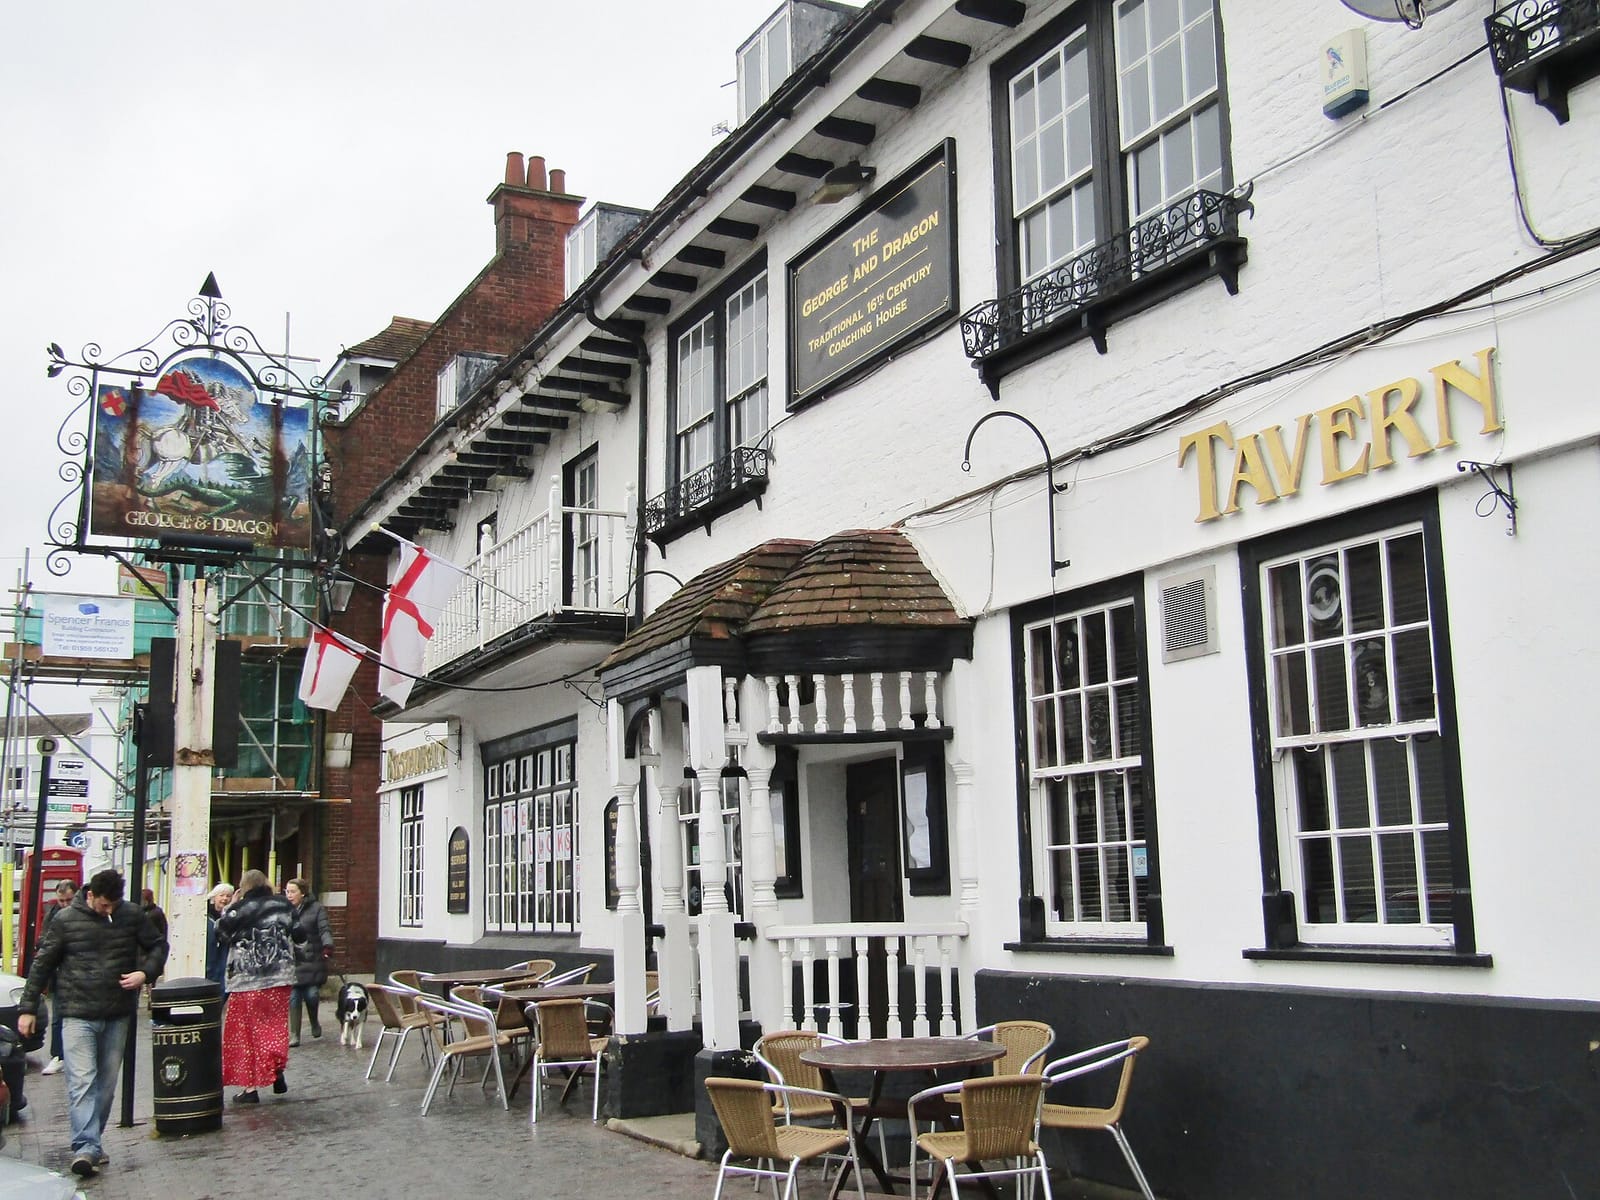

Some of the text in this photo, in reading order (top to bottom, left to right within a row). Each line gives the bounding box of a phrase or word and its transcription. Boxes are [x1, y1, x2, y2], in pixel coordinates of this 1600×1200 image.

[853, 228, 879, 256] THE
[802, 211, 939, 317] GEORGE AND DRAGON
[808, 310, 864, 352] TRADITIONAL
[886, 262, 932, 301] CENTURY
[828, 298, 908, 357] COACHING HOUSE
[1177, 346, 1504, 523] TAVERN
[125, 511, 192, 529] GEORGE
[213, 517, 279, 536] DRAGON
[48, 613, 130, 627] Spencer Francis
[42, 739, 56, 752] D
